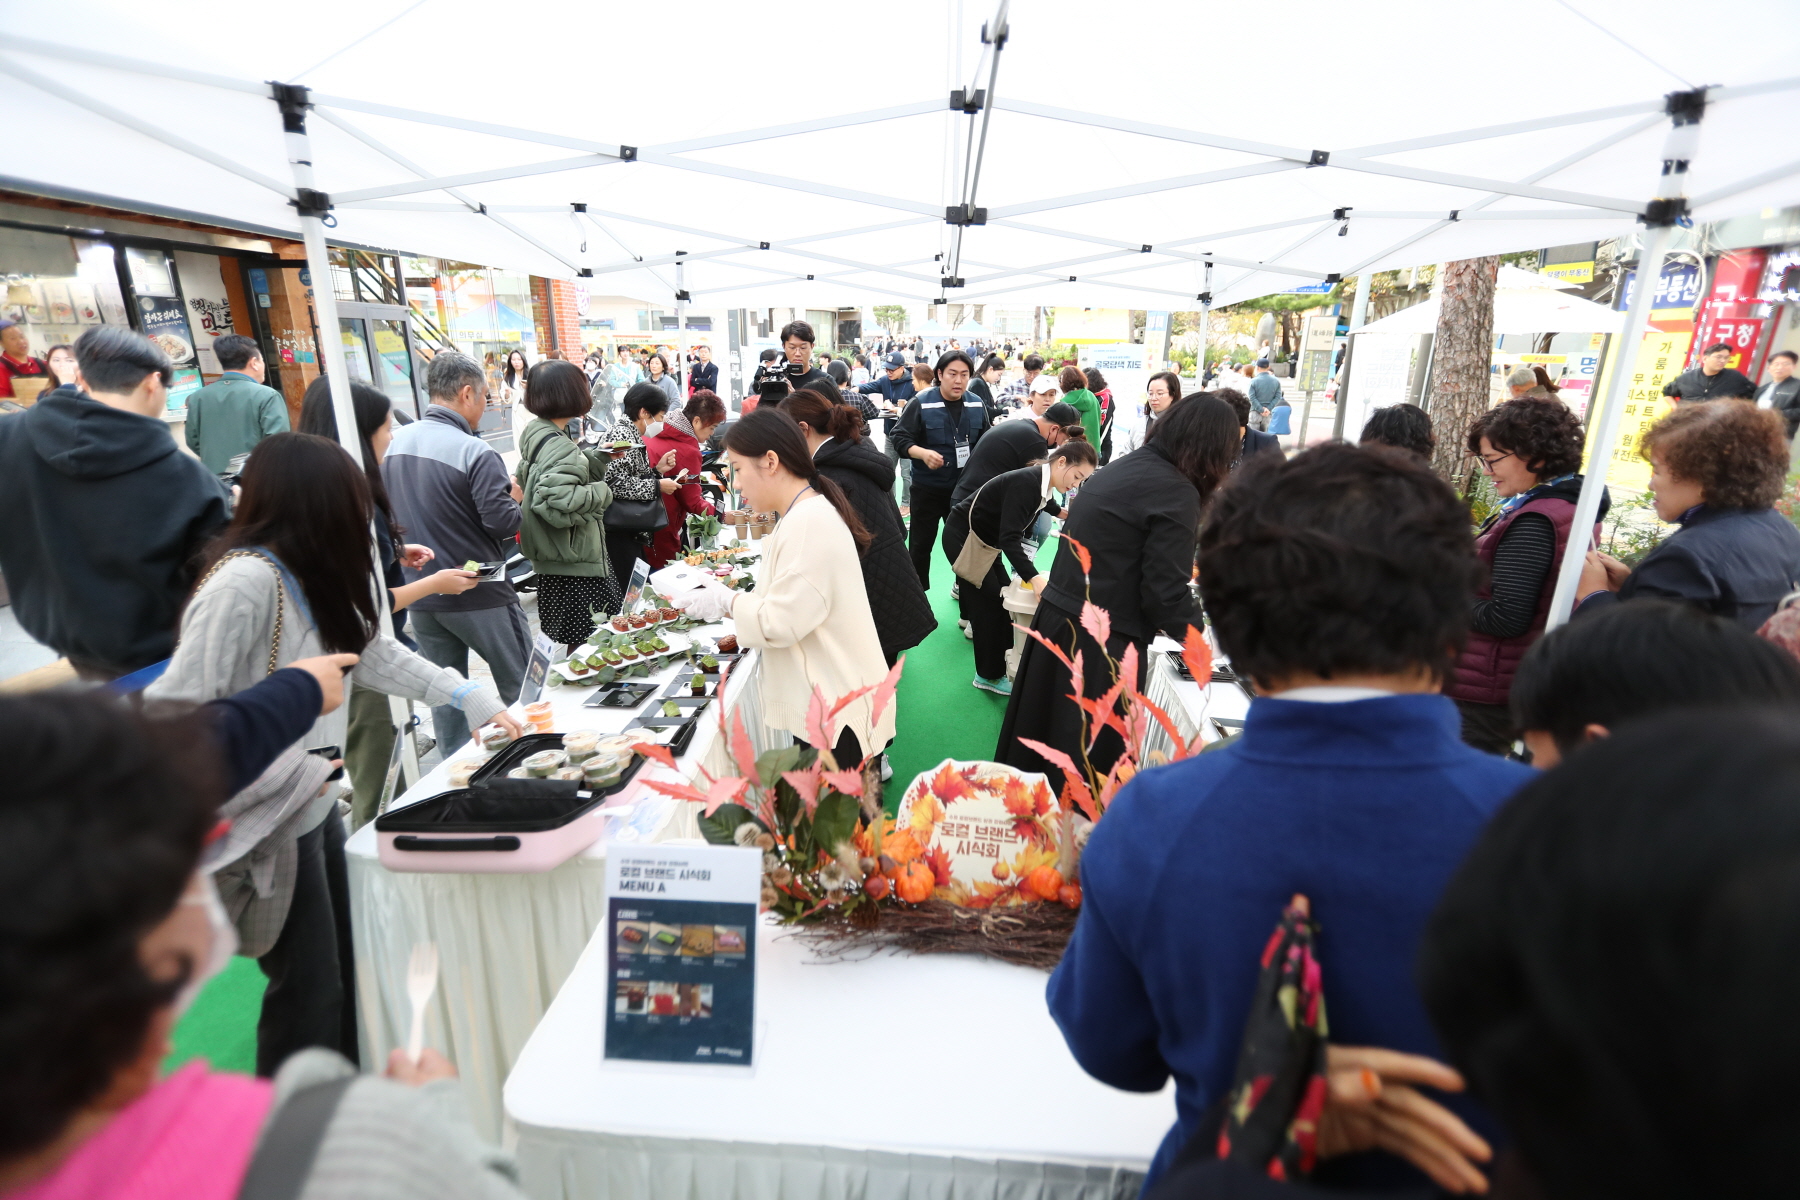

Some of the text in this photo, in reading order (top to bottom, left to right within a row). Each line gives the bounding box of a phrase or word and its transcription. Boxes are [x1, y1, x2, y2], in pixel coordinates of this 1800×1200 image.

[1568, 268, 1590, 277] 부동산
[1626, 273, 1700, 304] 부동산
[459, 331, 483, 340] 의무실
[1715, 324, 1755, 348] 구청
[1127, 360, 1142, 369] 지도
[1625, 404, 1654, 417] 파트
[941, 822, 1018, 844] 로컬 브랜드
[956, 840, 1000, 859] 시식회
[620, 866, 711, 881] 로컬 브랜드 시식회
[619, 880, 666, 893] MENU A
